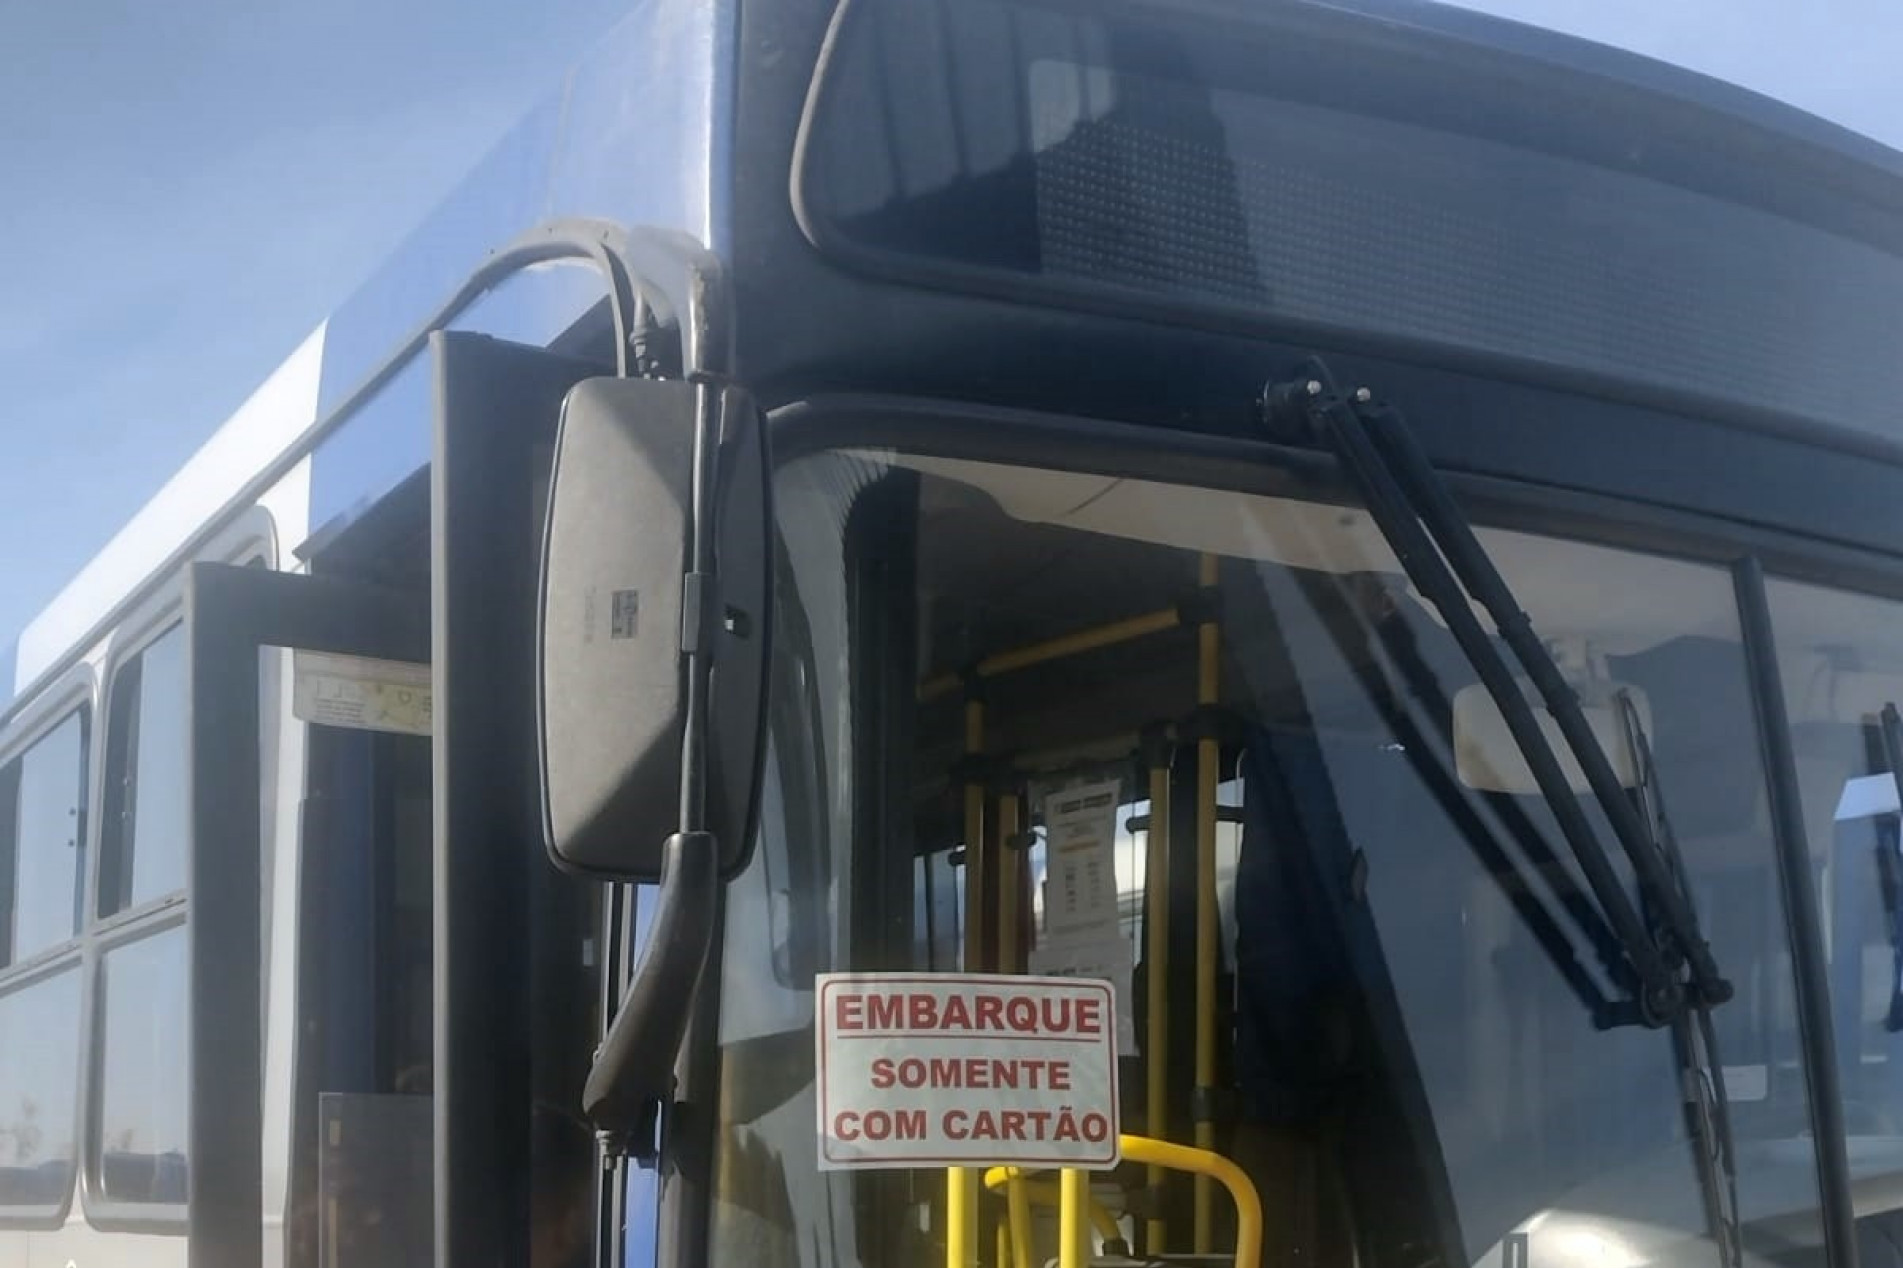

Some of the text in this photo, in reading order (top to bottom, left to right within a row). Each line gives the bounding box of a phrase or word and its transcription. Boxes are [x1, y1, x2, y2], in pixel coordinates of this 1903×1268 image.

[836, 993, 1101, 1034] EMBARQUE
[871, 1058, 1071, 1090] SOMENTE
[834, 1105, 1108, 1143] COM CARTÃO
